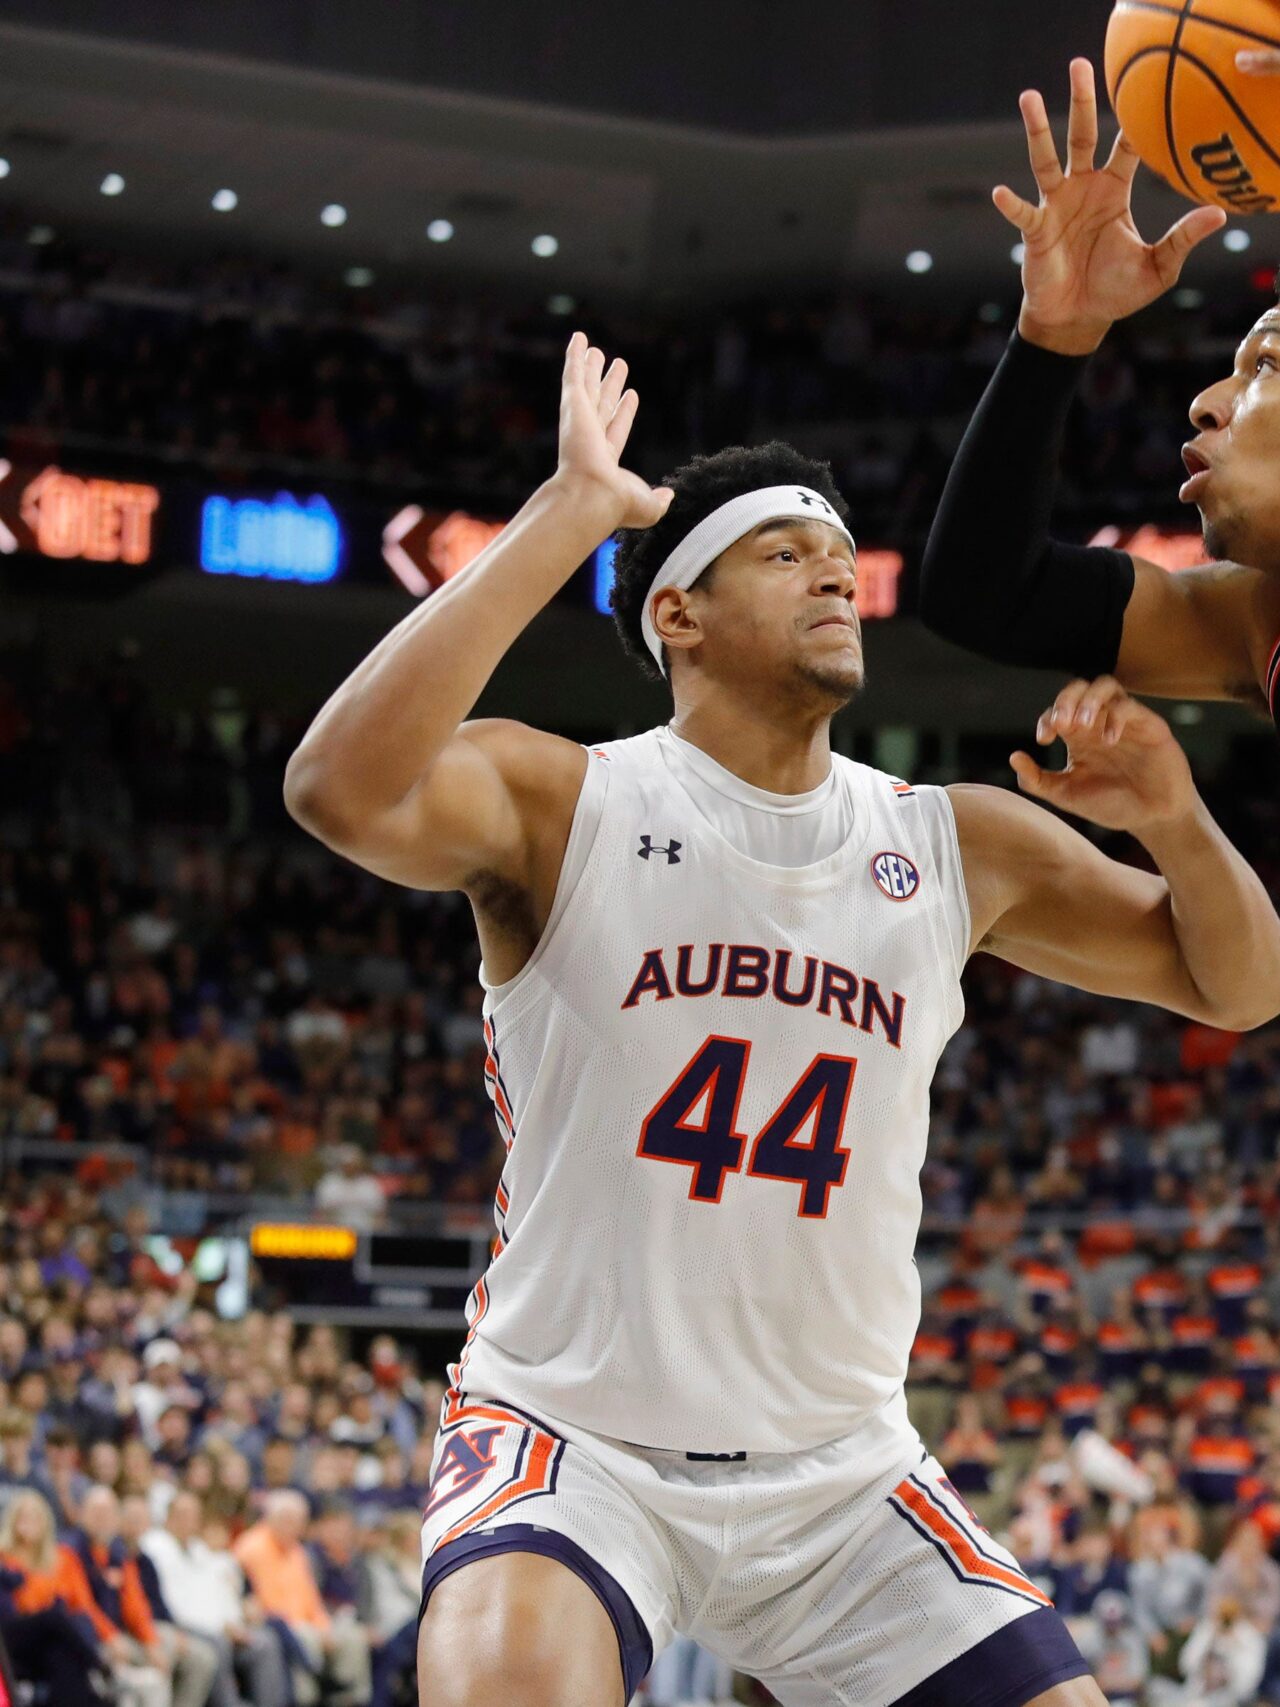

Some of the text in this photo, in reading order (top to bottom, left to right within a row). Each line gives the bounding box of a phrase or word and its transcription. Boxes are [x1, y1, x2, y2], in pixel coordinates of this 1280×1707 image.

[874, 854, 918, 898] SEC
[621, 943, 906, 1049] AUBURN
[636, 1034, 858, 1219] 44
